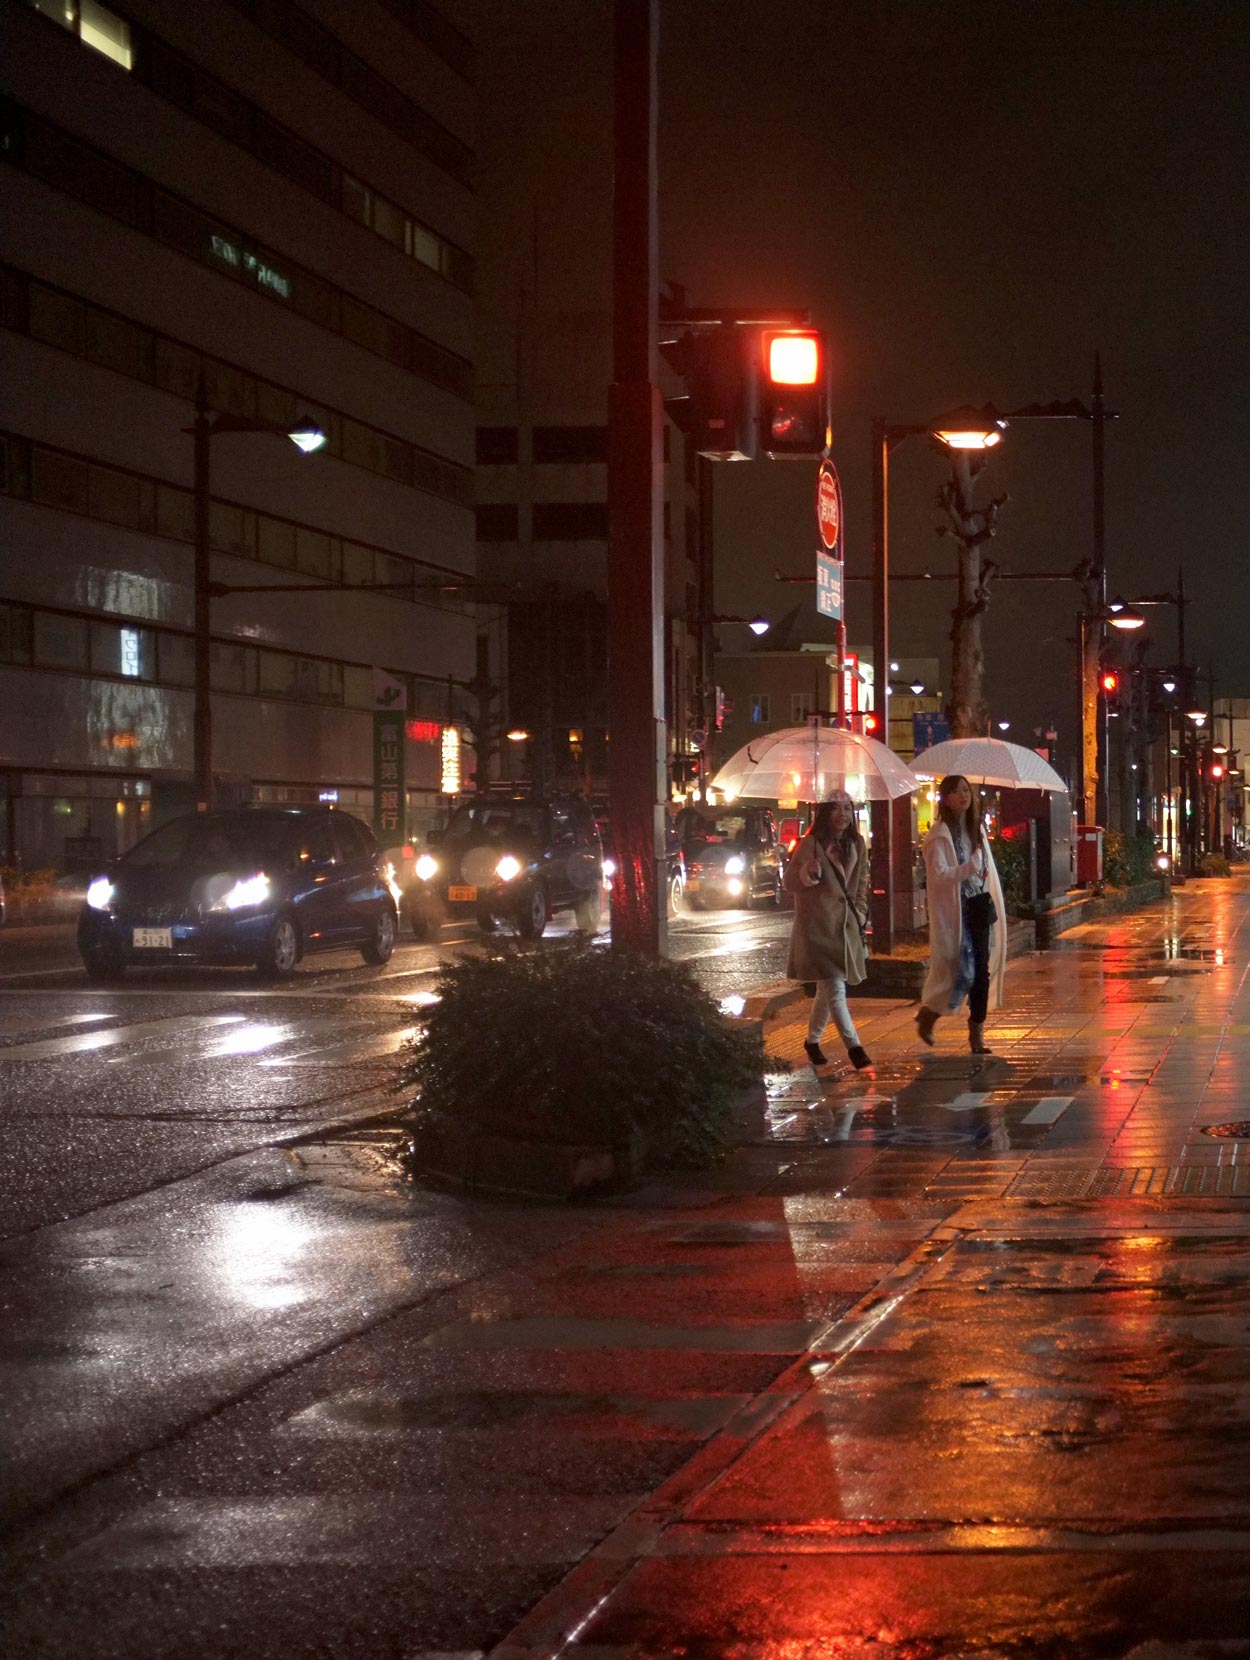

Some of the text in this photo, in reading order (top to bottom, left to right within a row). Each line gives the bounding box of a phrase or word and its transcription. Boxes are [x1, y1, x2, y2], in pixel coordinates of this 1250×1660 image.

[380, 725, 399, 830] 富山第一銀行
